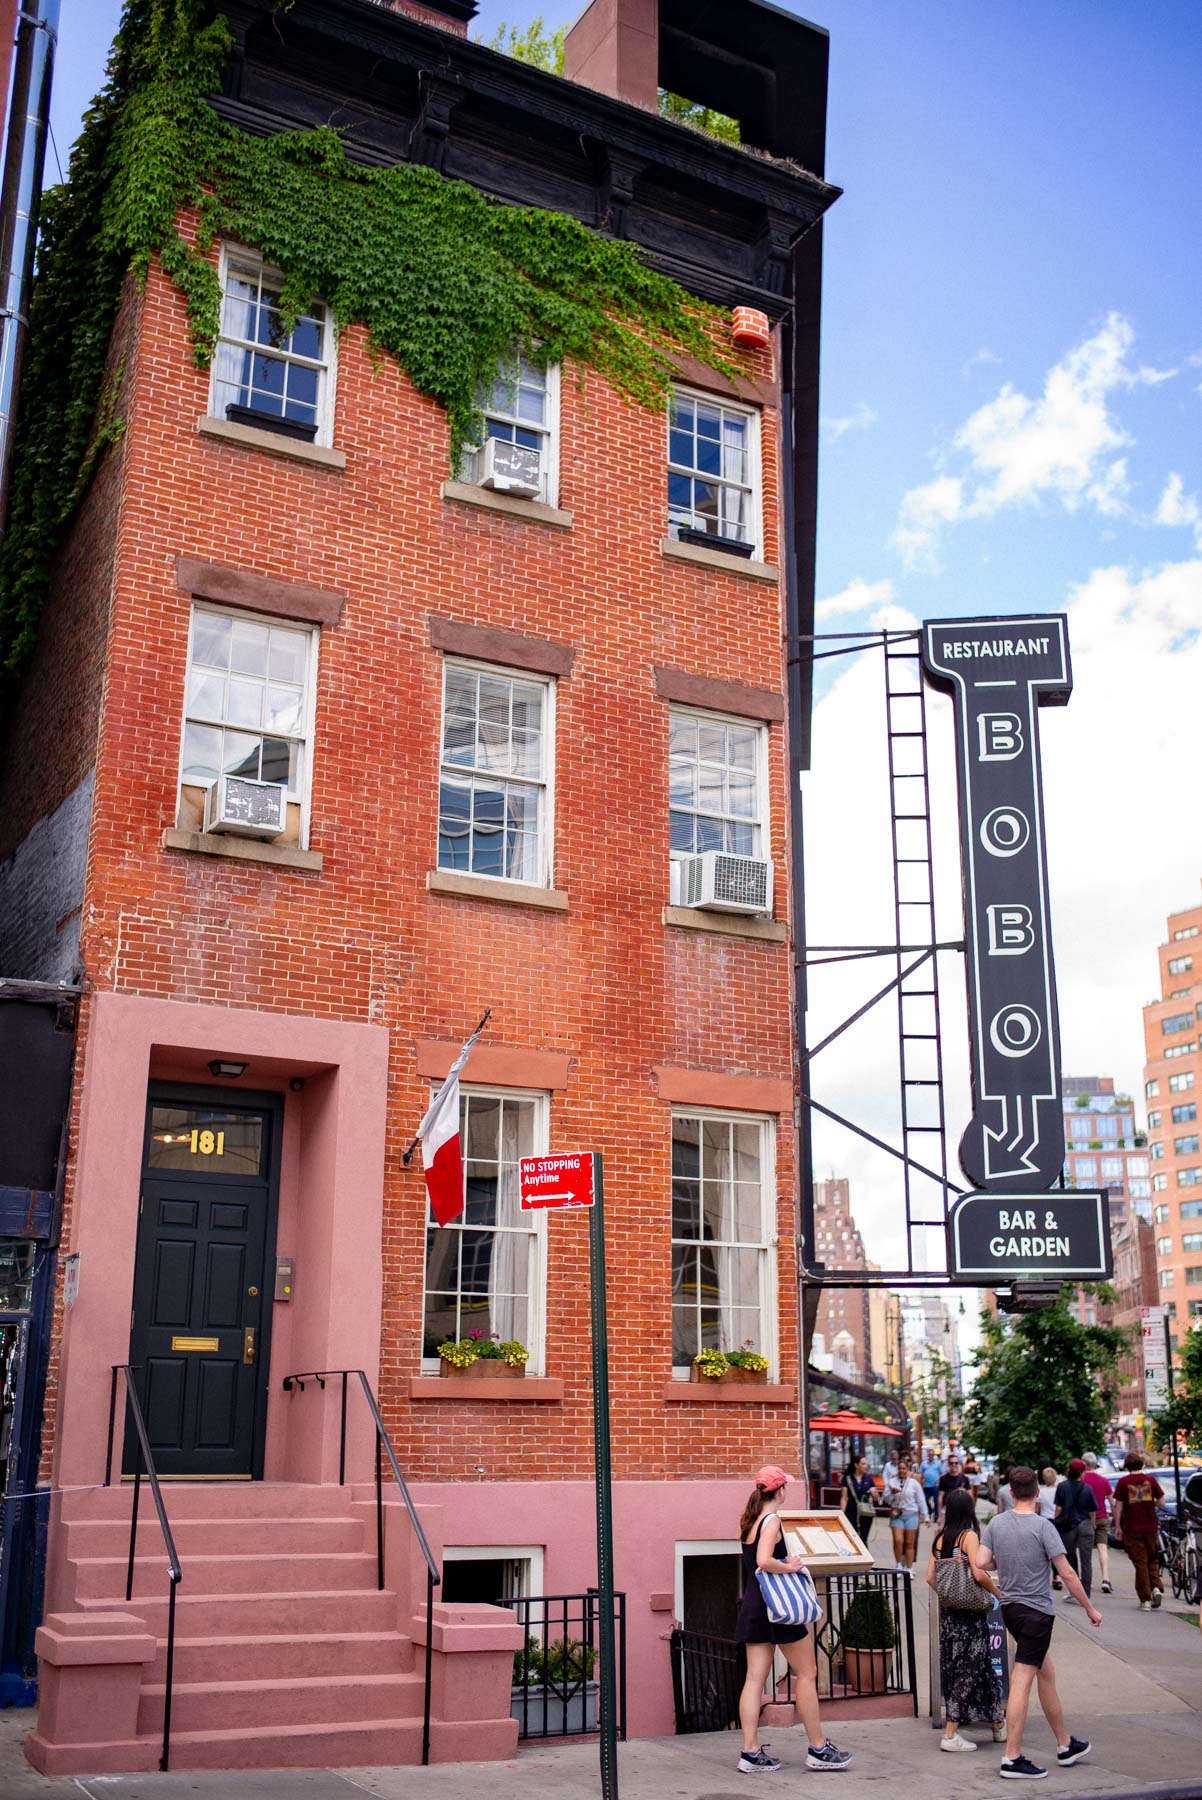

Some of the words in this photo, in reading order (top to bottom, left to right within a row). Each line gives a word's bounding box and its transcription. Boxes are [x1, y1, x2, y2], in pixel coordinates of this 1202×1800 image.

[943, 638, 1050, 659] RESTAURANT
[977, 713, 1041, 1058] BOBO
[190, 1130, 225, 1155] 181
[523, 1163, 536, 1173] NO
[538, 1159, 580, 1171] STOPPING
[524, 1174, 560, 1186] Anytime
[999, 1210, 1037, 1230] BAR
[1044, 1211, 1059, 1230] &
[989, 1237, 1071, 1257] GARDEN
